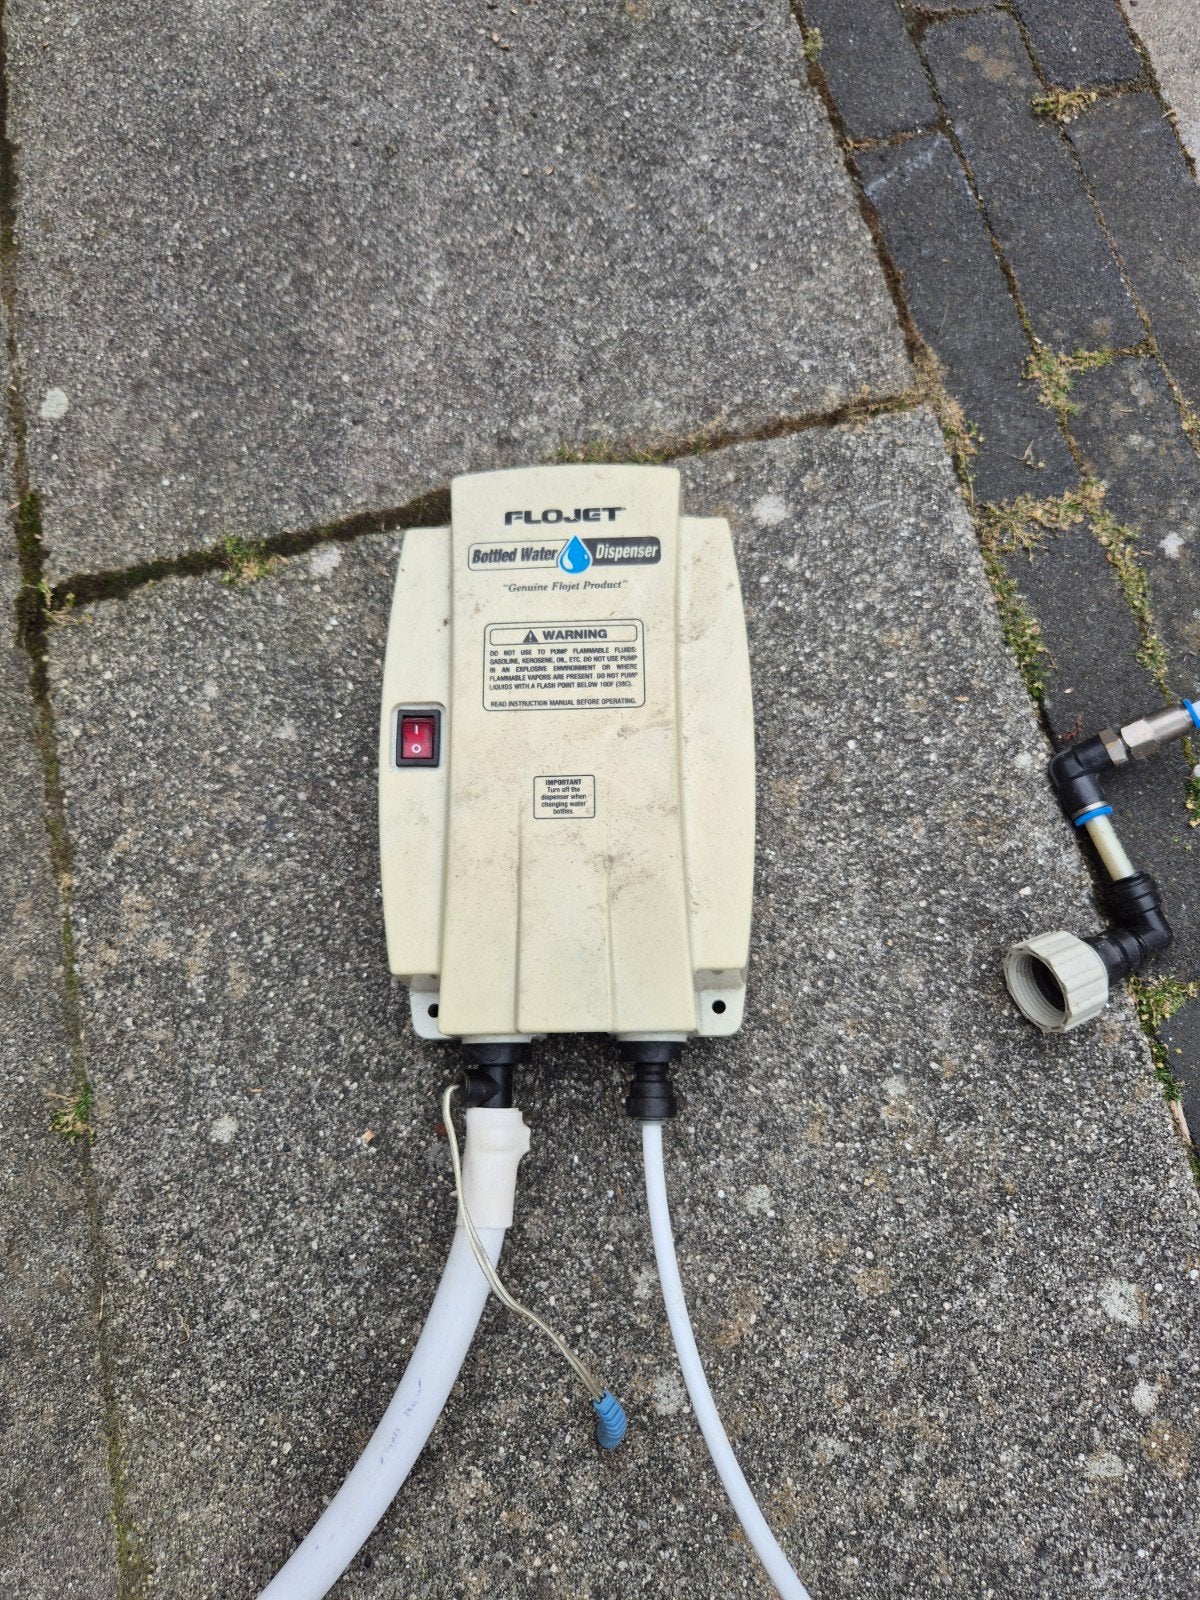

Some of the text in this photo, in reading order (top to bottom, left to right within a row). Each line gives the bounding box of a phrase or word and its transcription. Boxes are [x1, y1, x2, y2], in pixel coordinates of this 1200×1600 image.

[504, 507, 623, 525] FLOJET
[472, 543, 658, 563] Bottled Water Dispenser
[551, 583, 579, 592] Flojet
[543, 629, 608, 640] WARNING
